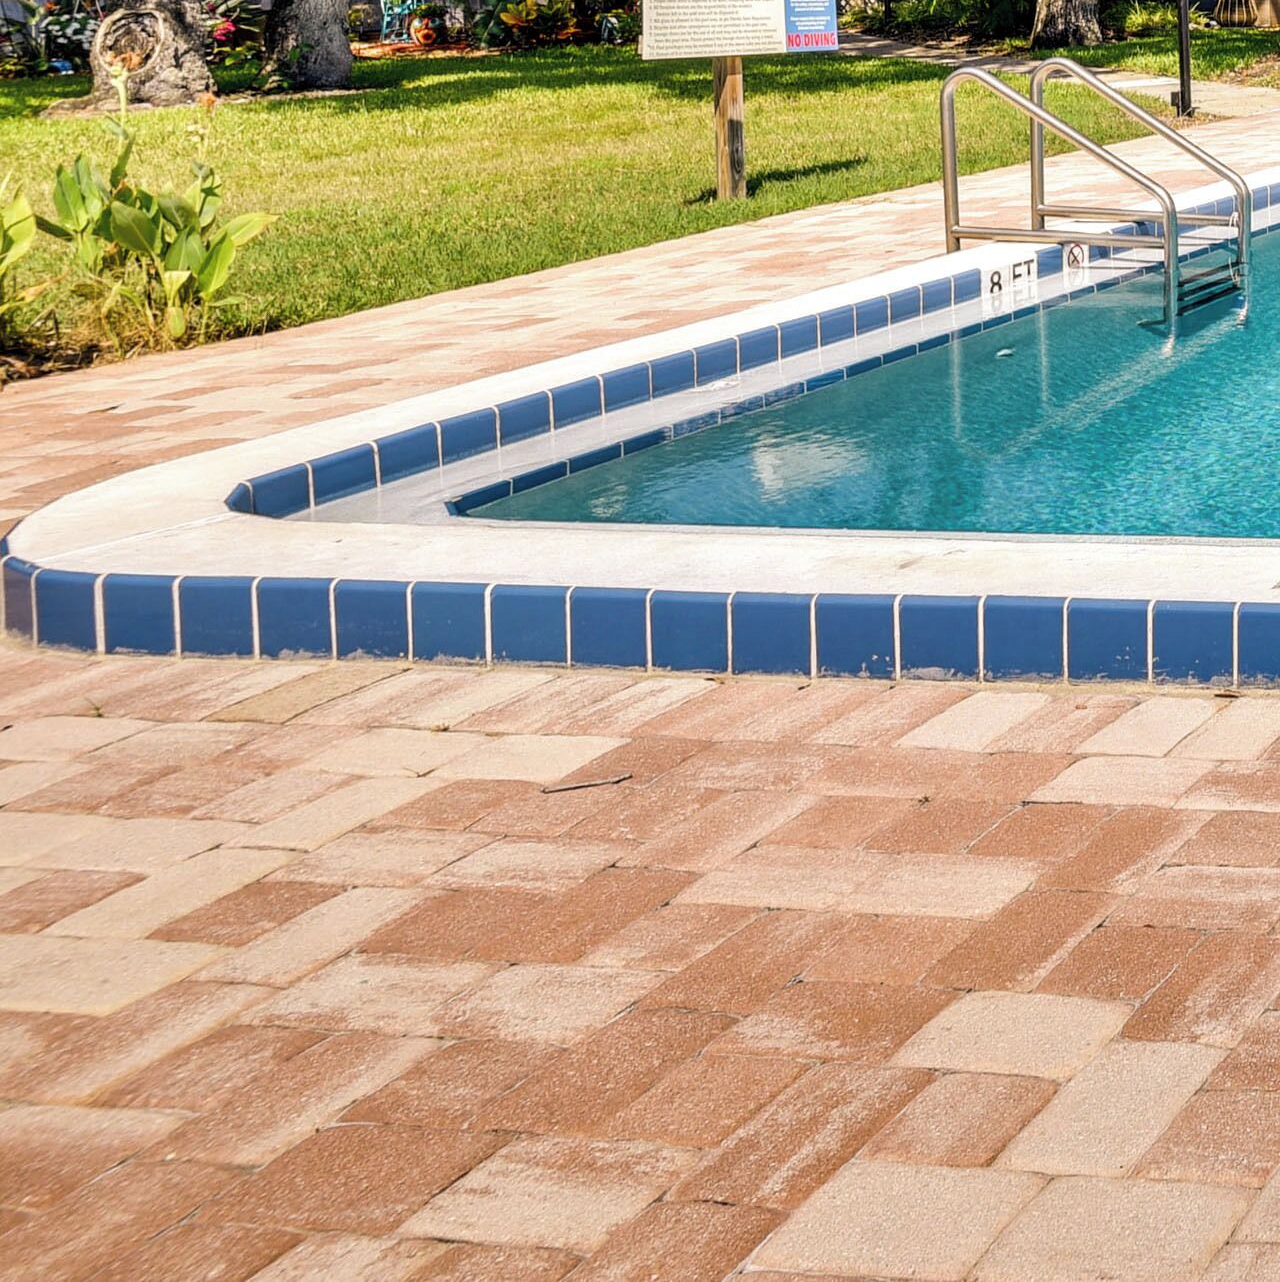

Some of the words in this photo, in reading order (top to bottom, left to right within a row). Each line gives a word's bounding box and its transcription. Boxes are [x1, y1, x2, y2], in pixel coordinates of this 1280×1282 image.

[787, 33, 802, 47] NO
[804, 32, 836, 47] DIVING
[990, 270, 1003, 294] 8
